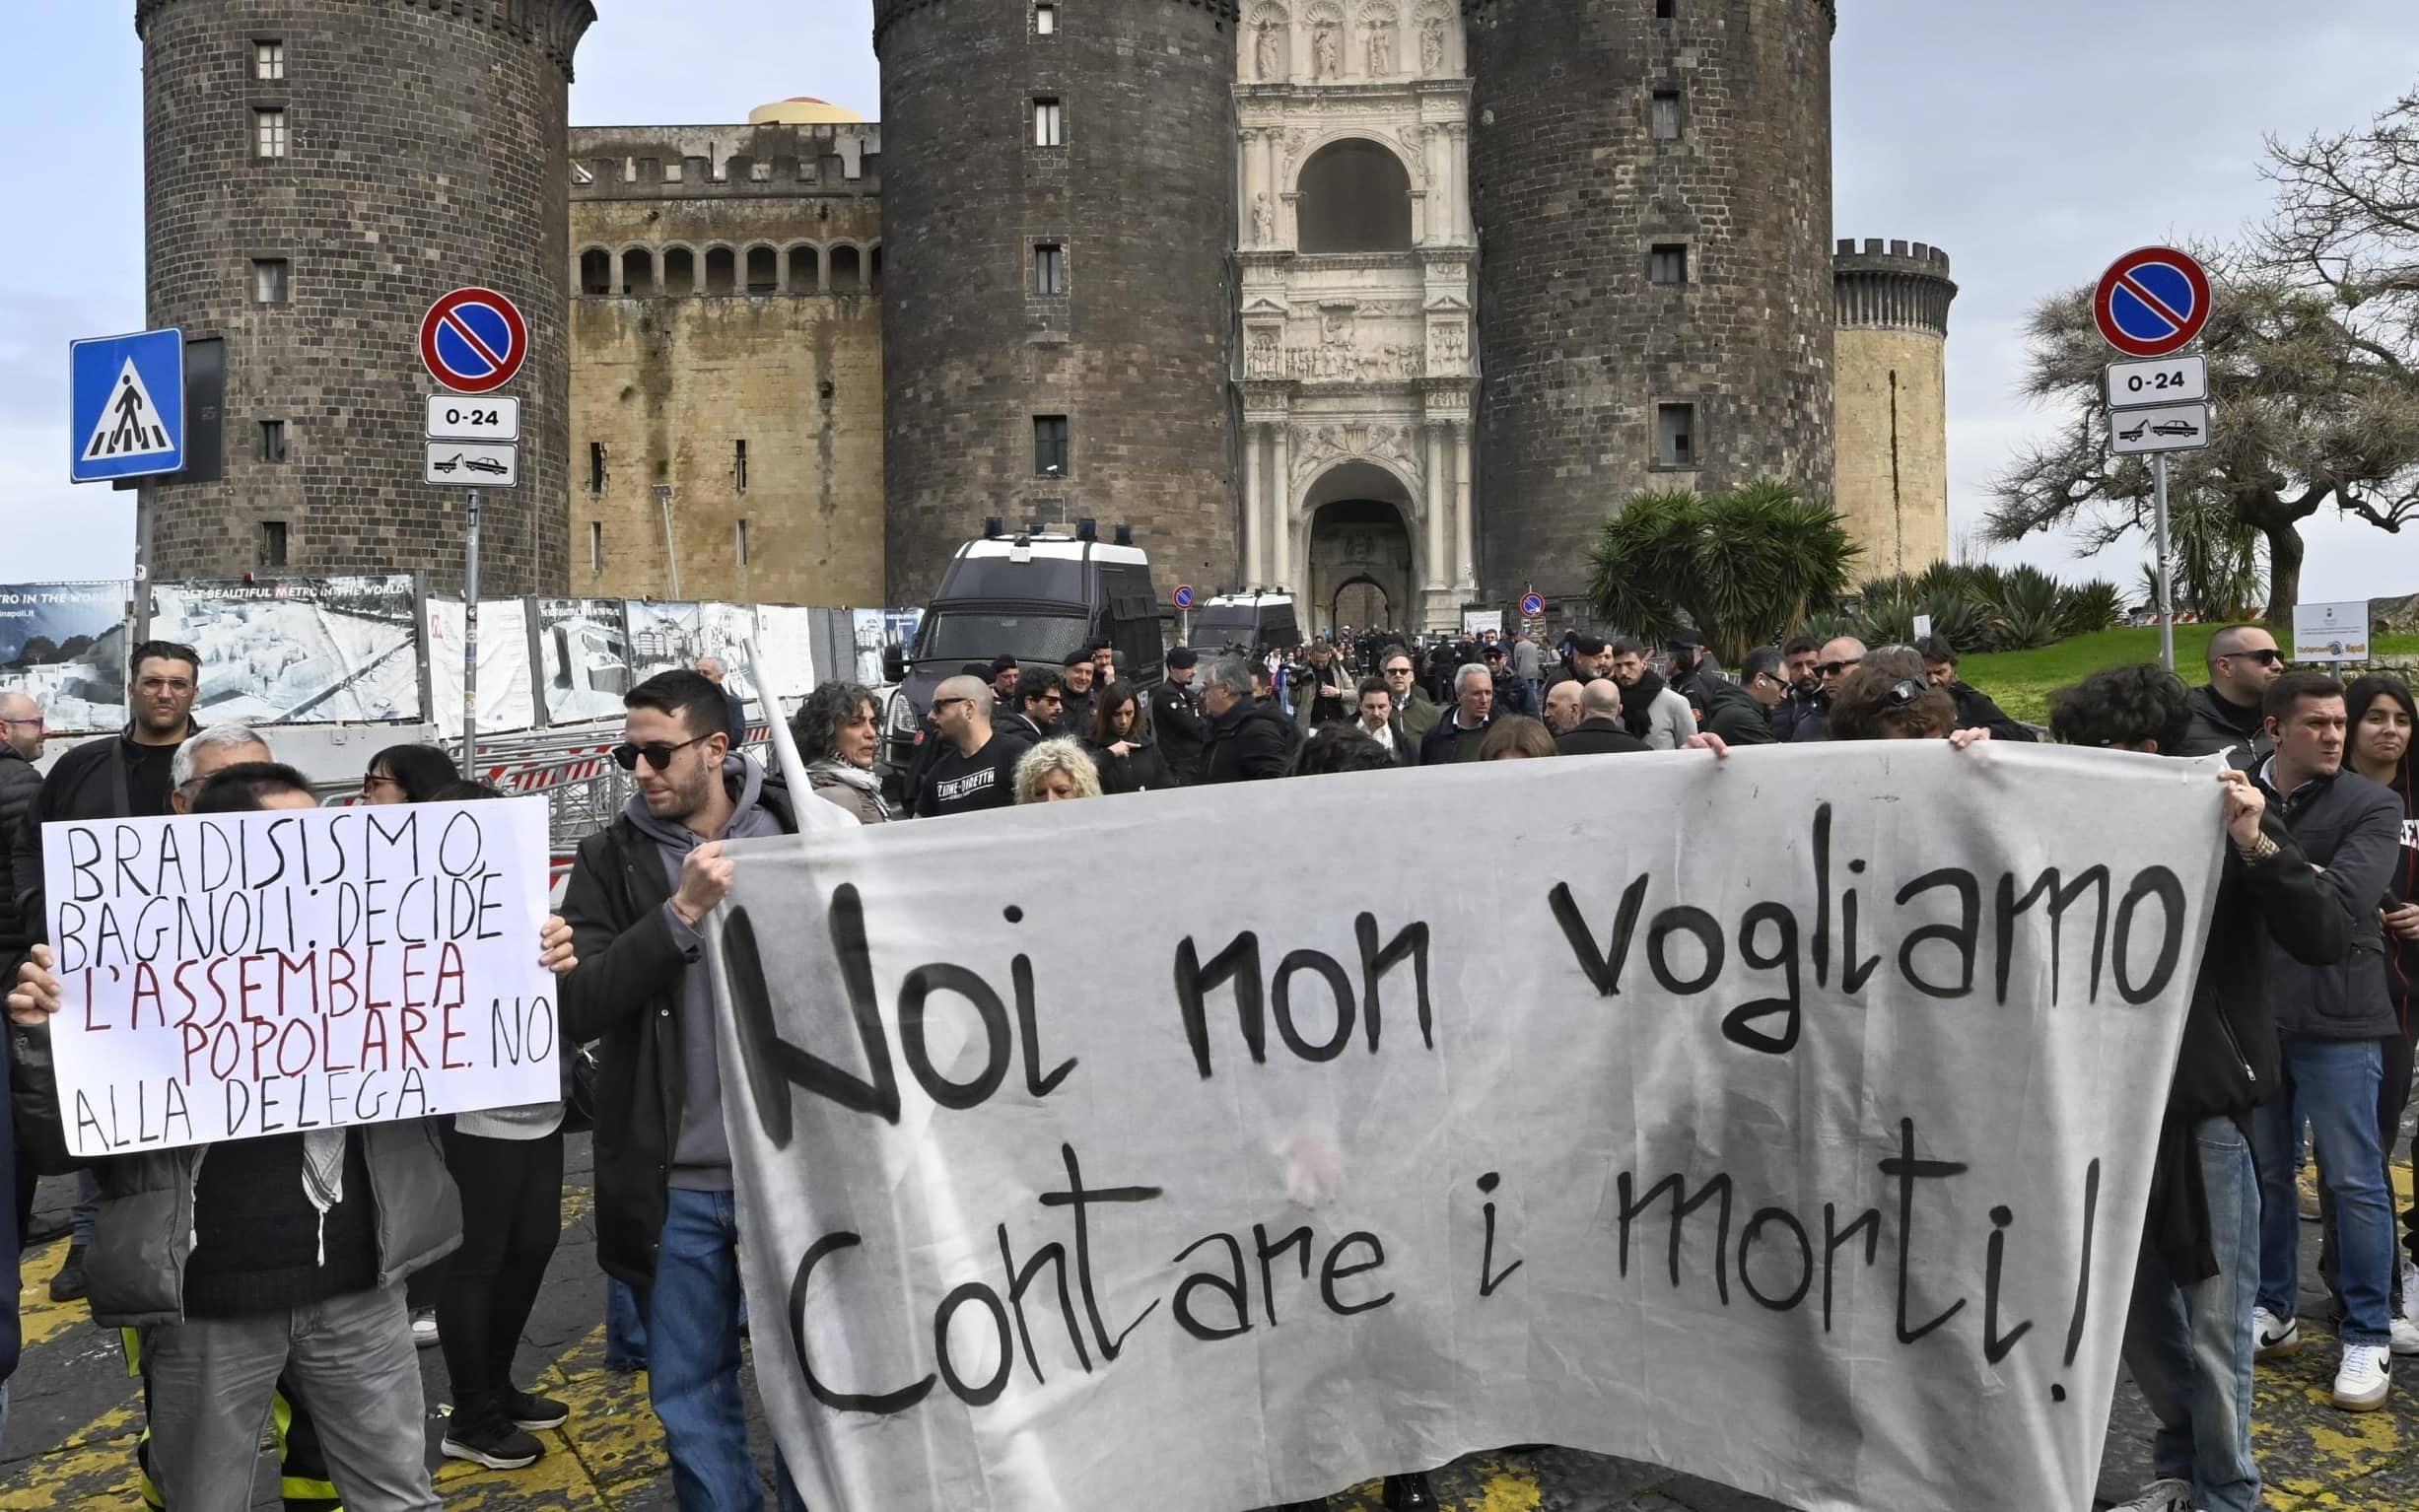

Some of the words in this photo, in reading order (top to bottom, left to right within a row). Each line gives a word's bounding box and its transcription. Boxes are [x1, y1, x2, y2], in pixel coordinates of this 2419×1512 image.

[446, 408, 499, 426] 0-24
[2127, 371, 2184, 392] 0-24
[23, 593, 37, 604] IN
[40, 592, 66, 603] THE
[207, 587, 272, 599] BEAUTIFUL
[363, 583, 404, 595] WORLD
[67, 810, 487, 903] BRADISISMO,
[337, 872, 504, 947] DECIDE
[83, 941, 466, 1032] L'ASSEMBLEA
[1174, 911, 1434, 1078] non
[182, 1000, 474, 1086] POPOLARE.
[491, 996, 553, 1068] NO
[76, 1076, 192, 1153] ALLA
[226, 1066, 439, 1134] DELEGA.
[1477, 1172, 1523, 1297] i
[1618, 1116, 2100, 1404] morti!
